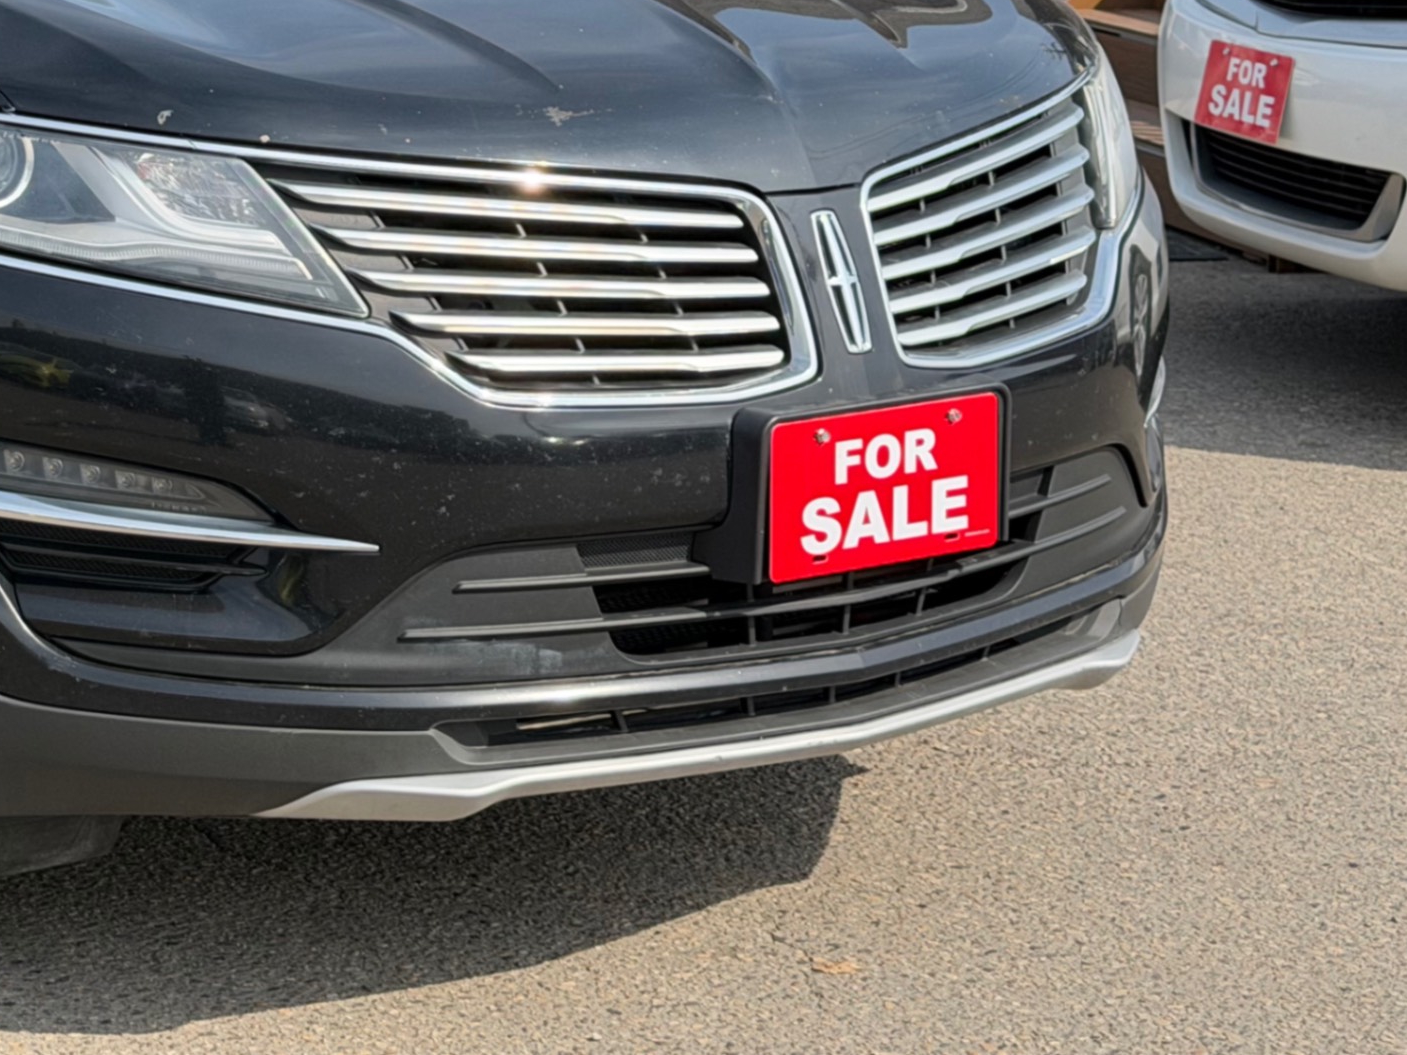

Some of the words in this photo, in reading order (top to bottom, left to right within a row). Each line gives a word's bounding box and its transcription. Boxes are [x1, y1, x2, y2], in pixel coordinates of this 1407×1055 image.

[1226, 57, 1267, 89] FOR
[1208, 84, 1276, 129] SALE
[834, 428, 938, 486] FOR
[800, 475, 969, 556] SALE
